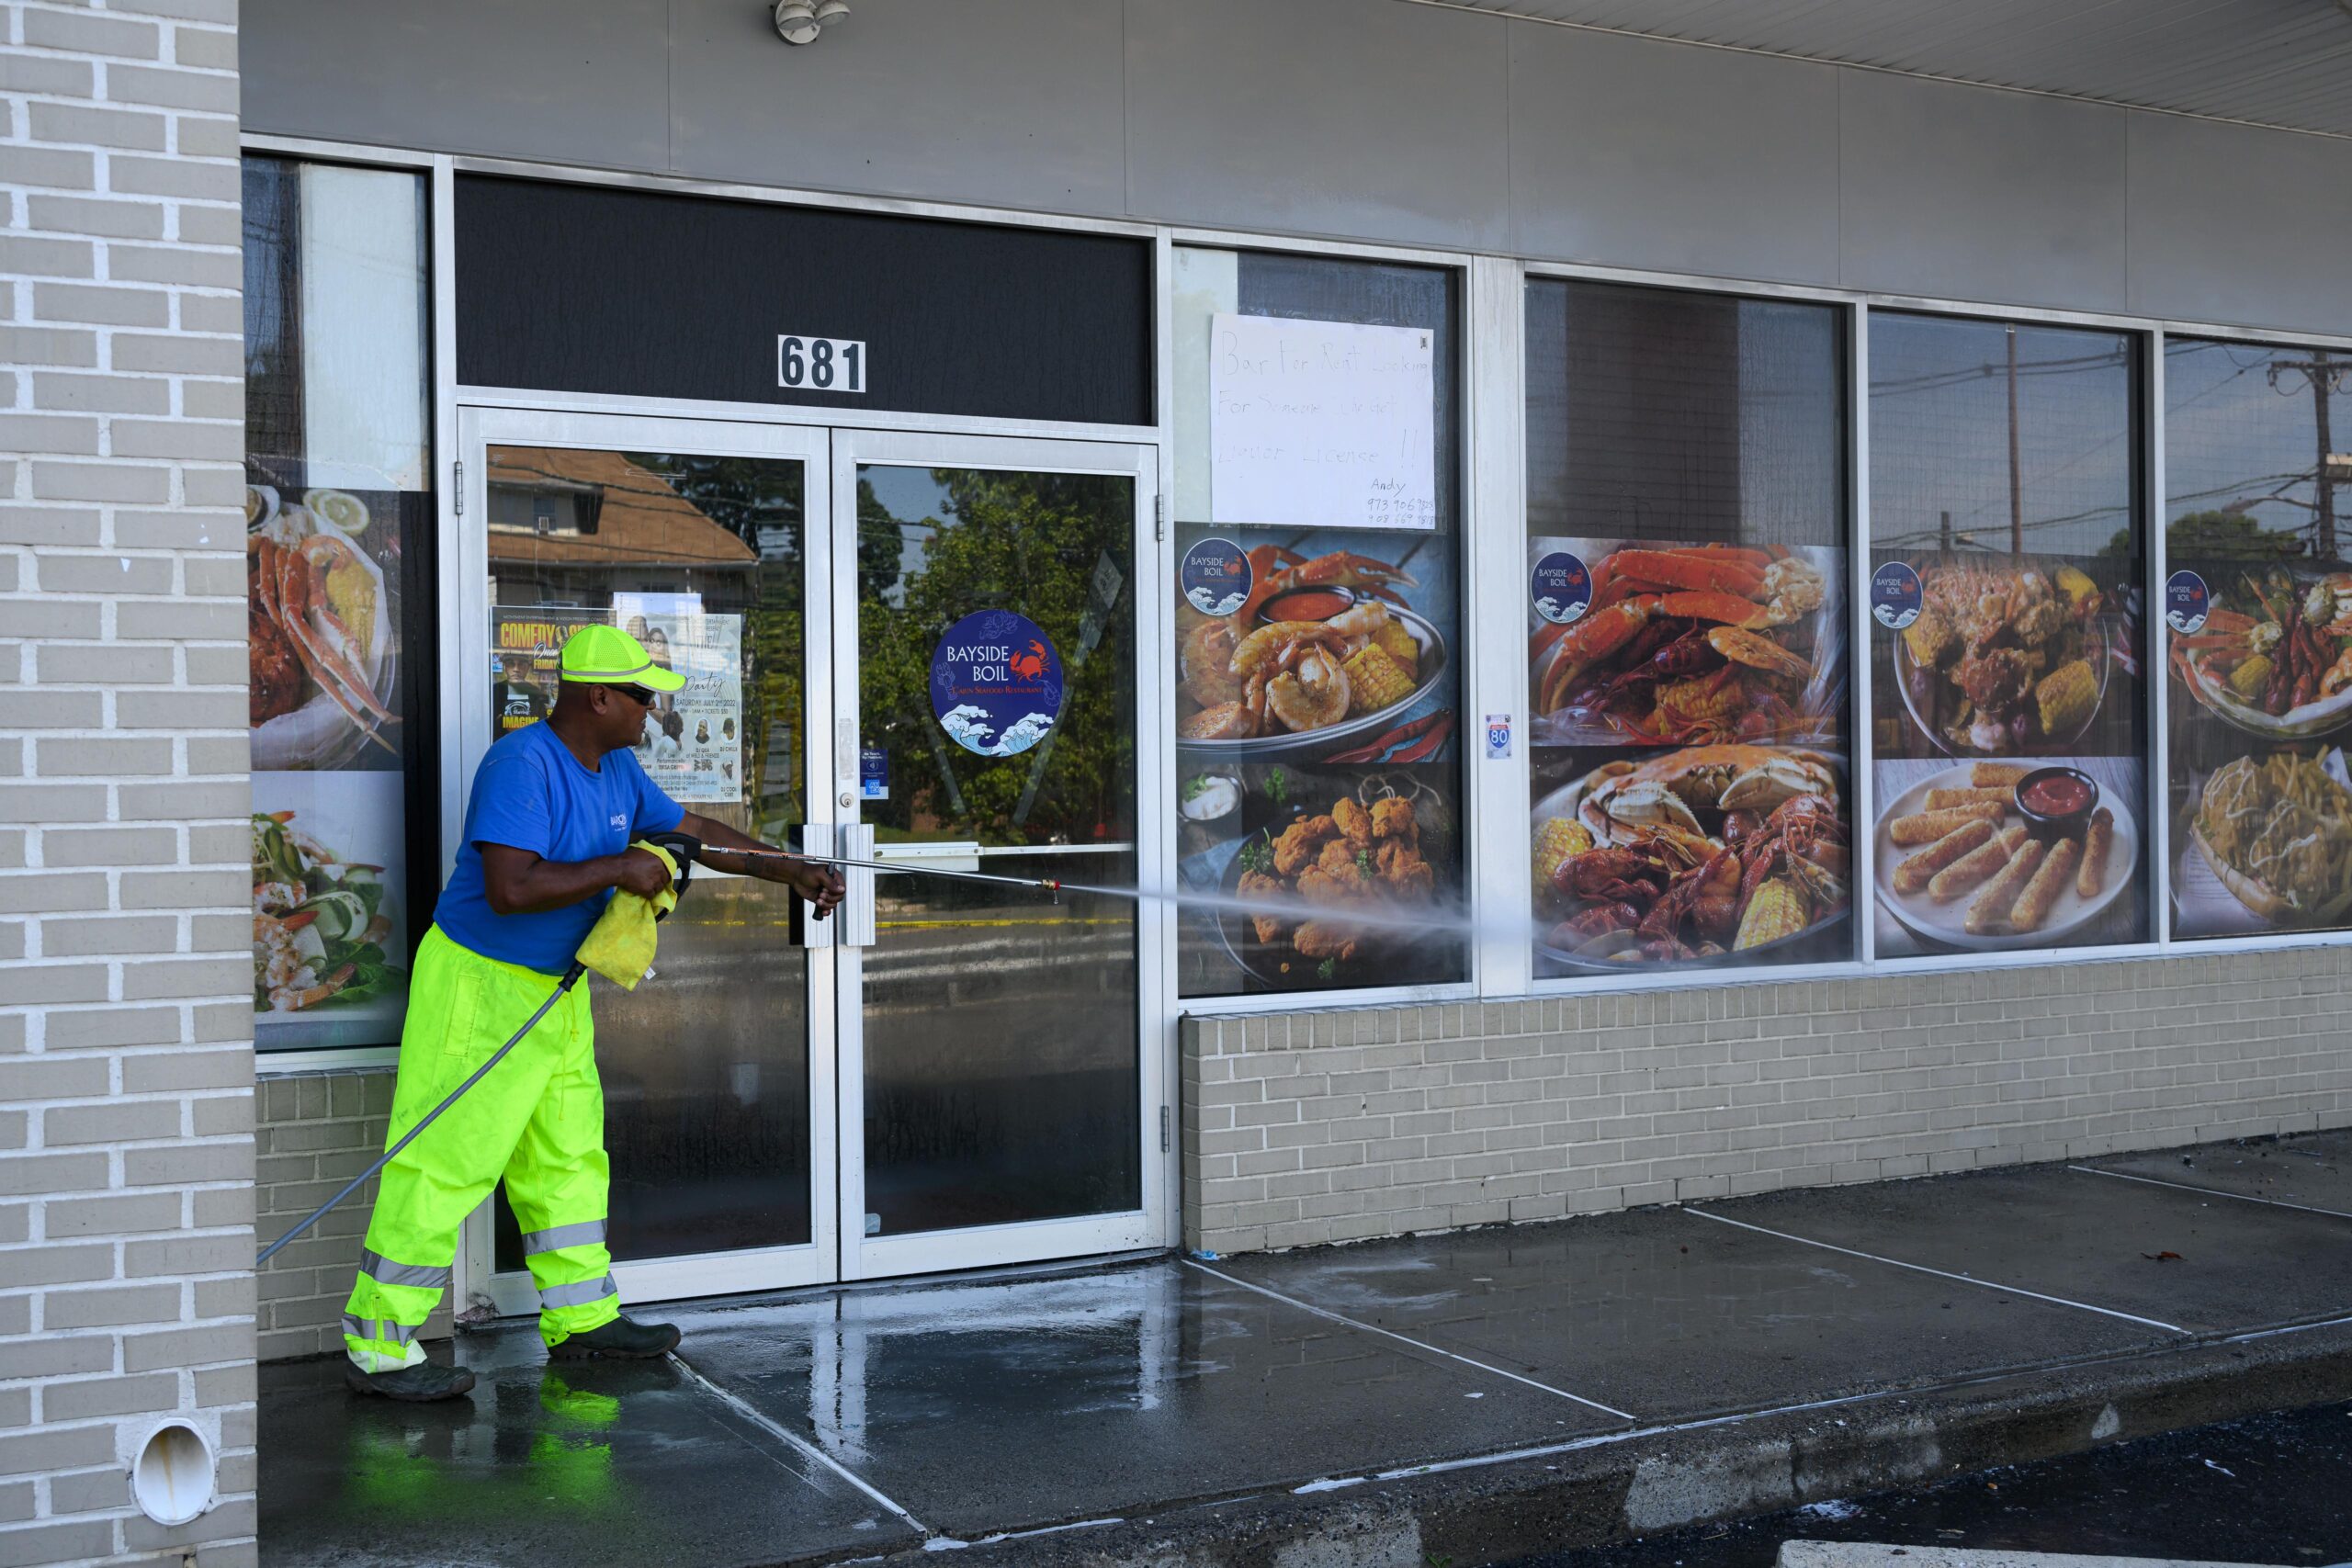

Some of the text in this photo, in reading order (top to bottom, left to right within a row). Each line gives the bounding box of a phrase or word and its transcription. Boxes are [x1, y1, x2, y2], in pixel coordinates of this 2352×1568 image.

[1222, 331, 1271, 375] Bar
[1279, 339, 1308, 375] For
[1320, 342, 1361, 372] Rent
[781, 336, 859, 390] 681
[1218, 389, 1251, 415] For
[1371, 477, 1406, 498] Andy
[1367, 498, 1389, 512] 973
[1393, 498, 1416, 512] 906
[1191, 557, 1224, 567] BAYSIDE
[1204, 567, 1224, 577] BOIL
[1538, 569, 1567, 577] BAYSIDE
[1550, 578, 1566, 587] BOIL
[1876, 578, 1902, 587] BAYSIDE
[1886, 587, 1901, 595] BOIL
[2177, 593, 2190, 602] BOIL
[501, 623, 556, 648] COMEDY
[947, 646, 1010, 662] BAYSIDE
[973, 665, 1009, 682] BOIL
[683, 671, 726, 698] Party
[1491, 730, 1508, 744] 80
